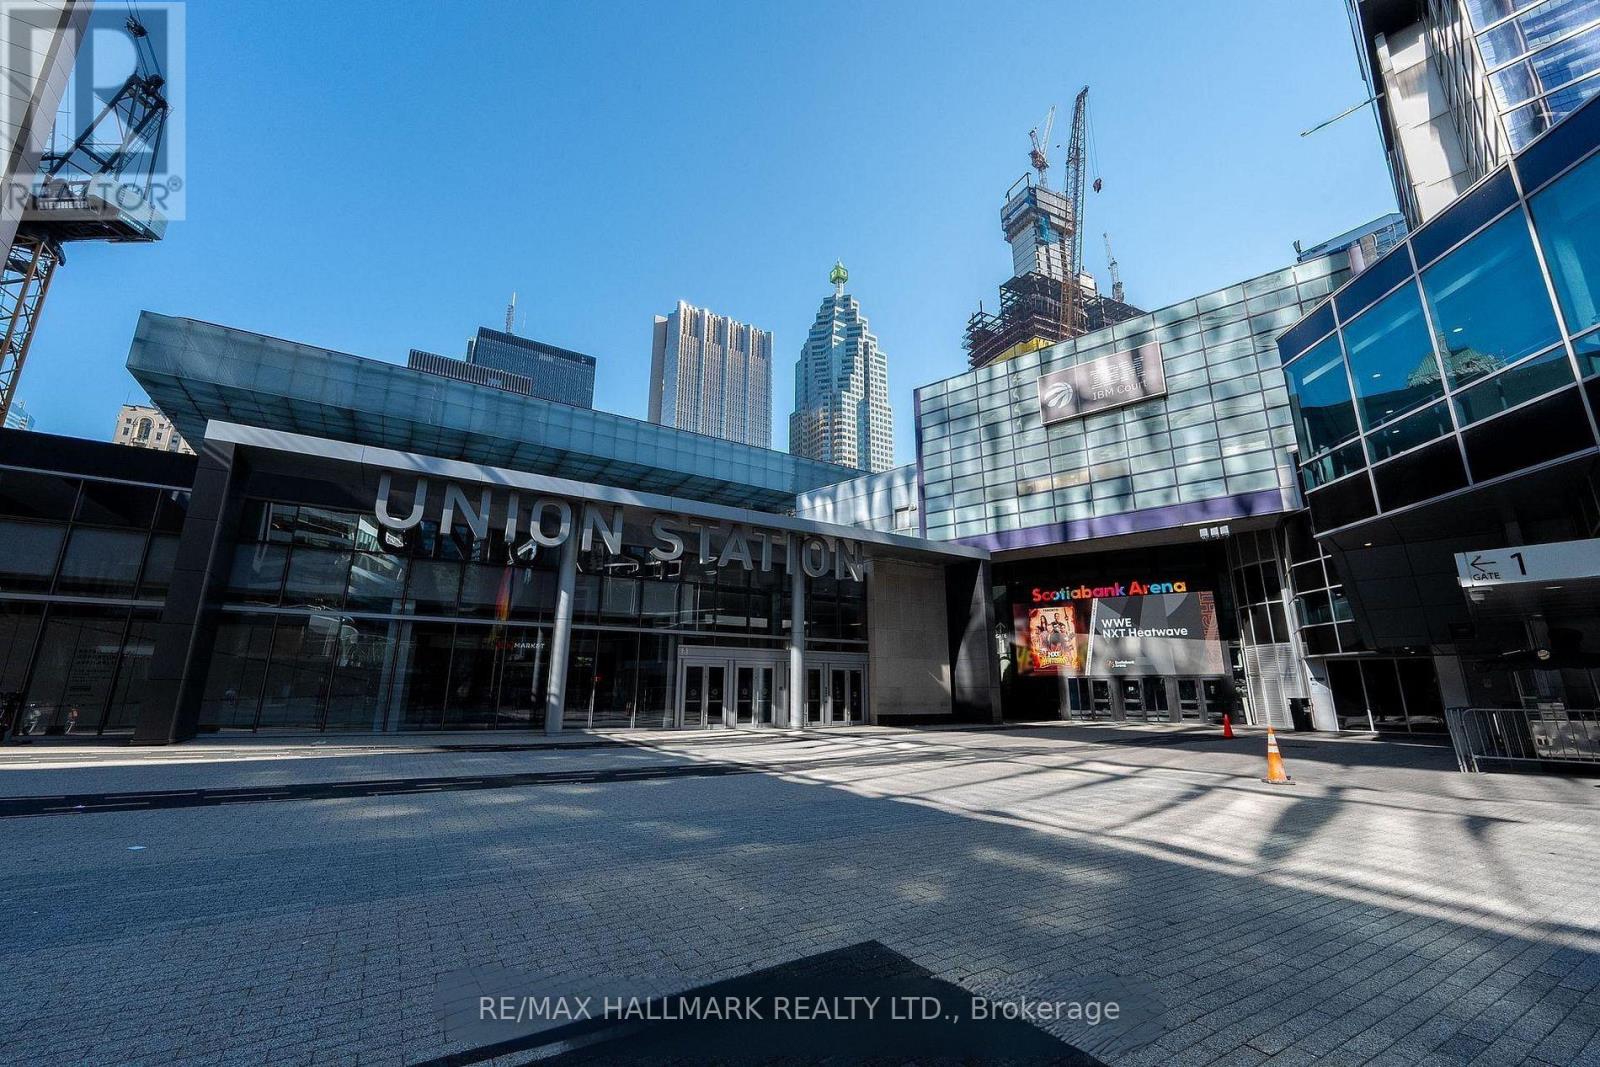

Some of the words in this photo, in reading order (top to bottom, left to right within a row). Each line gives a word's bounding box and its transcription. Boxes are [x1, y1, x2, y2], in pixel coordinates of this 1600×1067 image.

[1092, 386, 1115, 401] IBM
[1117, 378, 1148, 394] Court
[375, 472, 624, 557] UNION
[650, 516, 865, 583] STATION
[1510, 552, 1527, 576] 1
[1472, 571, 1501, 581] GATE
[1032, 582, 1126, 602] Scotiabank
[1129, 580, 1188, 597] Arena
[1101, 617, 1132, 629] WWE
[1102, 628, 1126, 639] NXT
[1128, 626, 1189, 638] Heatwave
